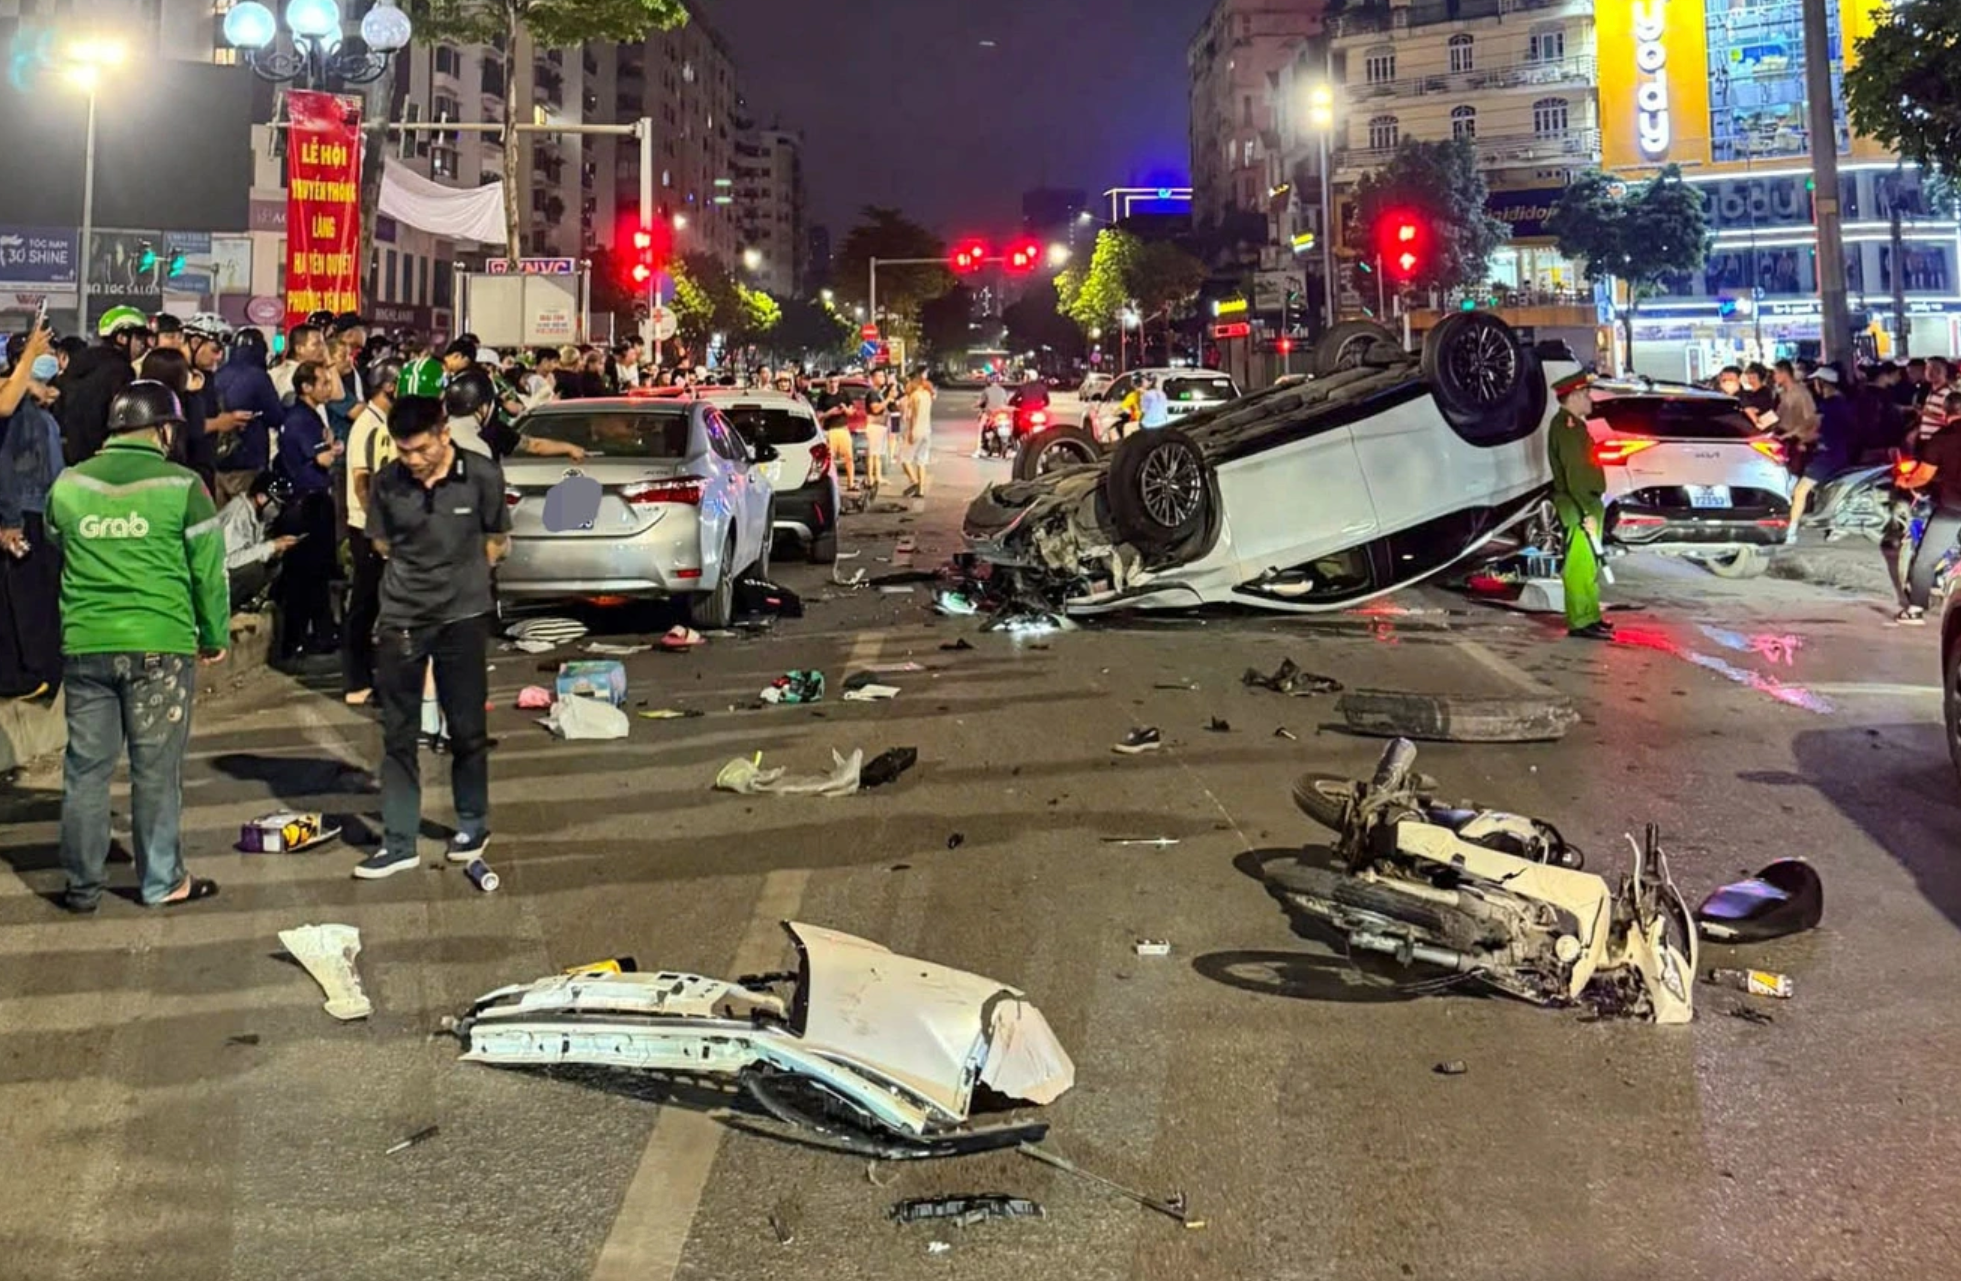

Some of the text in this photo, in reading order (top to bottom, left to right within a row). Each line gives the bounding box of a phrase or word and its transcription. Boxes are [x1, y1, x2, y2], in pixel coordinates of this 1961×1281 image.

[1632, 0, 1670, 152] yody
[320, 141, 347, 170] HỘI
[8, 247, 69, 264] 30 SHINE
[79, 511, 149, 538] Grab
